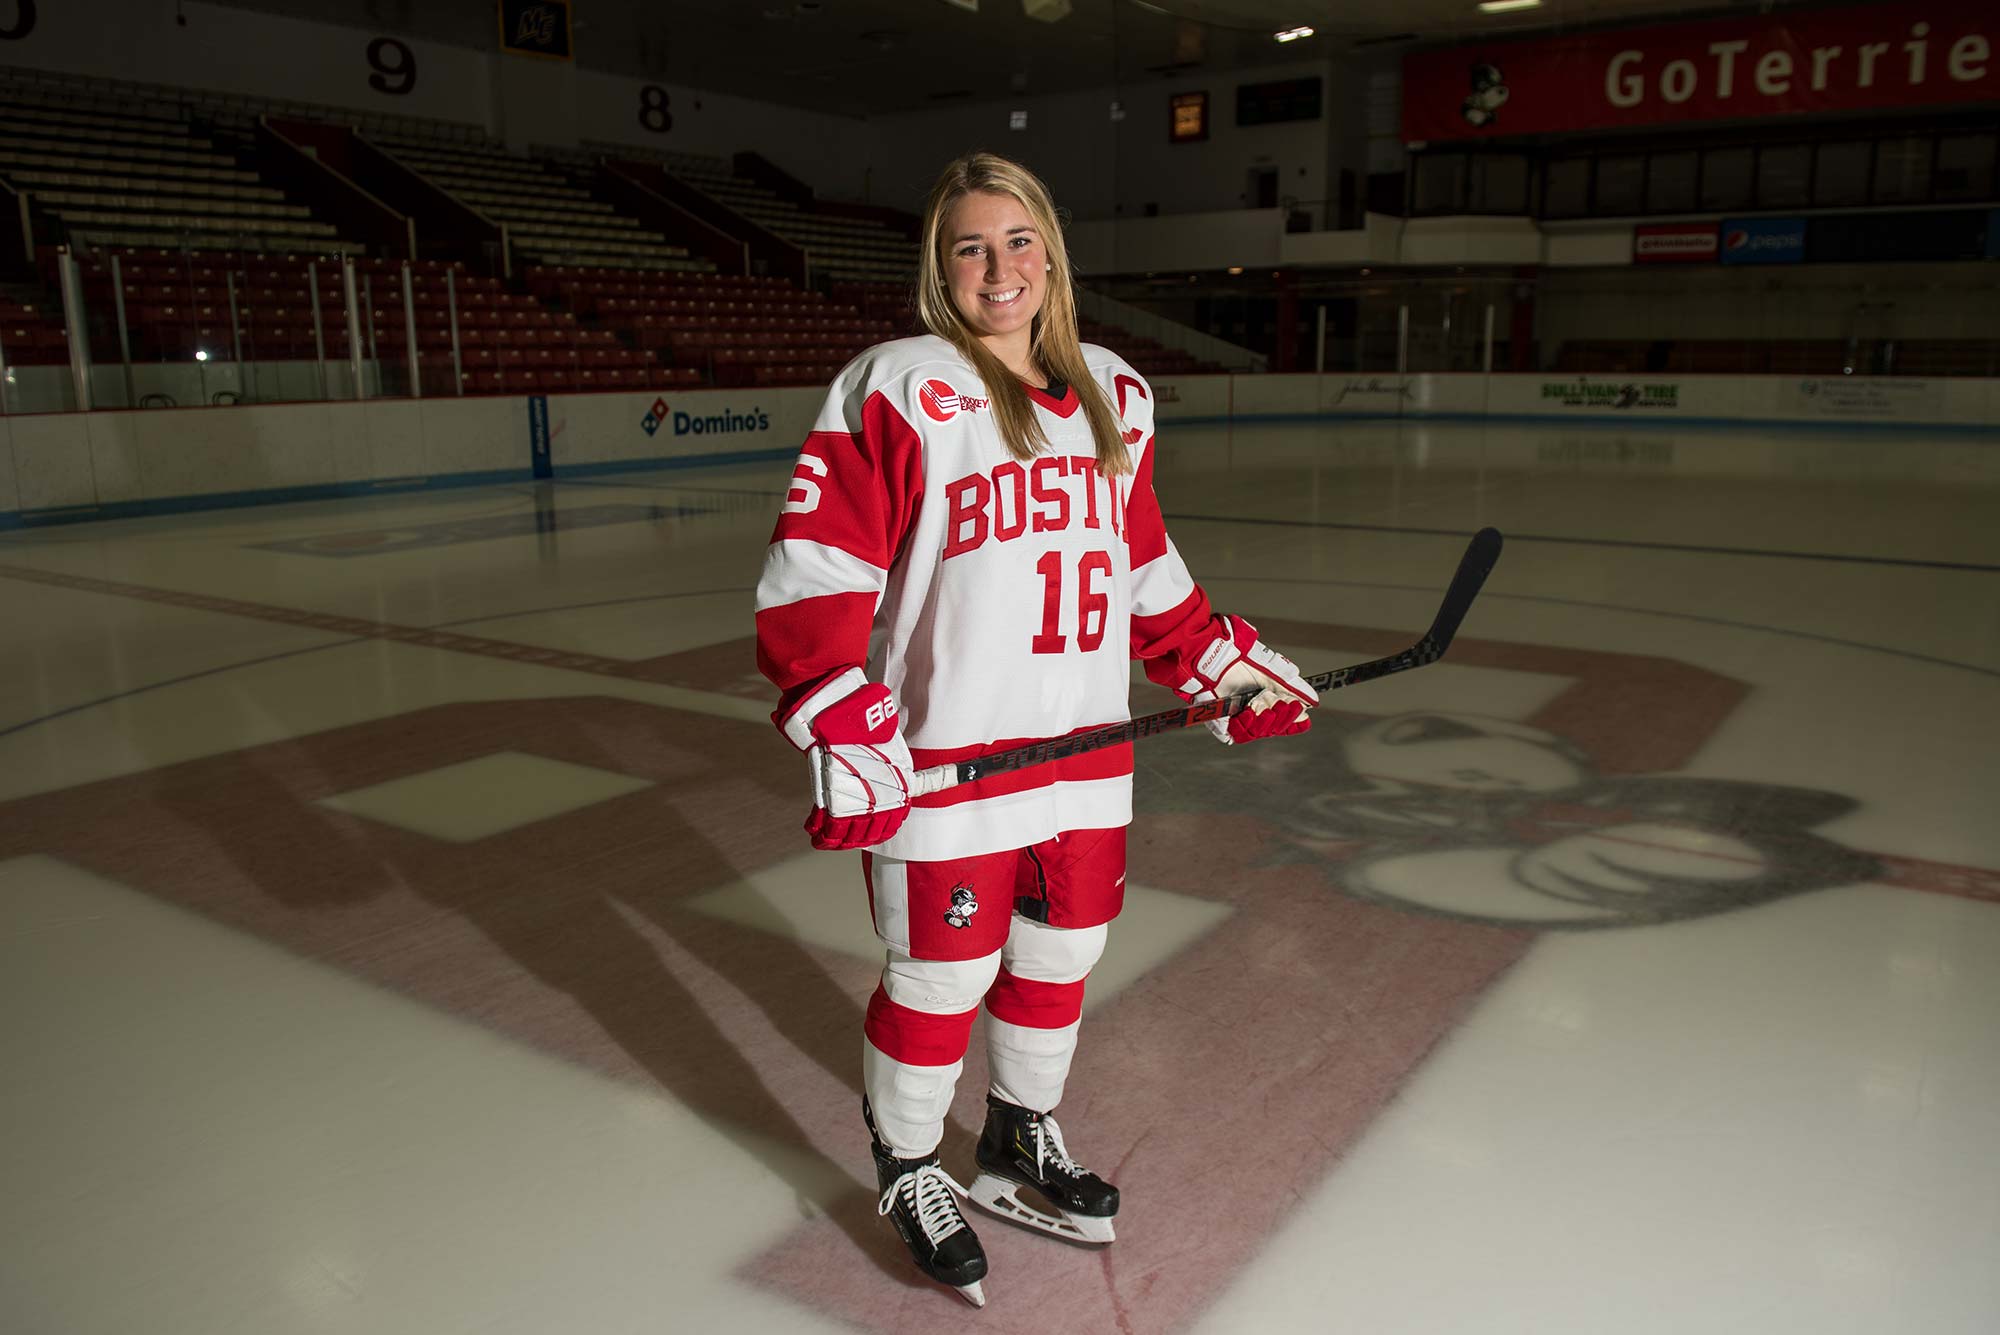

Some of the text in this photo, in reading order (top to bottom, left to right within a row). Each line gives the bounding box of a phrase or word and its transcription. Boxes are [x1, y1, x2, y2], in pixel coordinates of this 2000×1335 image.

[367, 38, 416, 94] 9
[1604, 21, 1991, 109] GoTerrie
[639, 85, 672, 133] 8
[1114, 374, 1147, 444] C
[1541, 378, 1679, 398] SULLIVAN TIRE
[674, 407, 769, 435] Domino's
[781, 453, 828, 514] 6
[1032, 550, 1113, 655] 16
